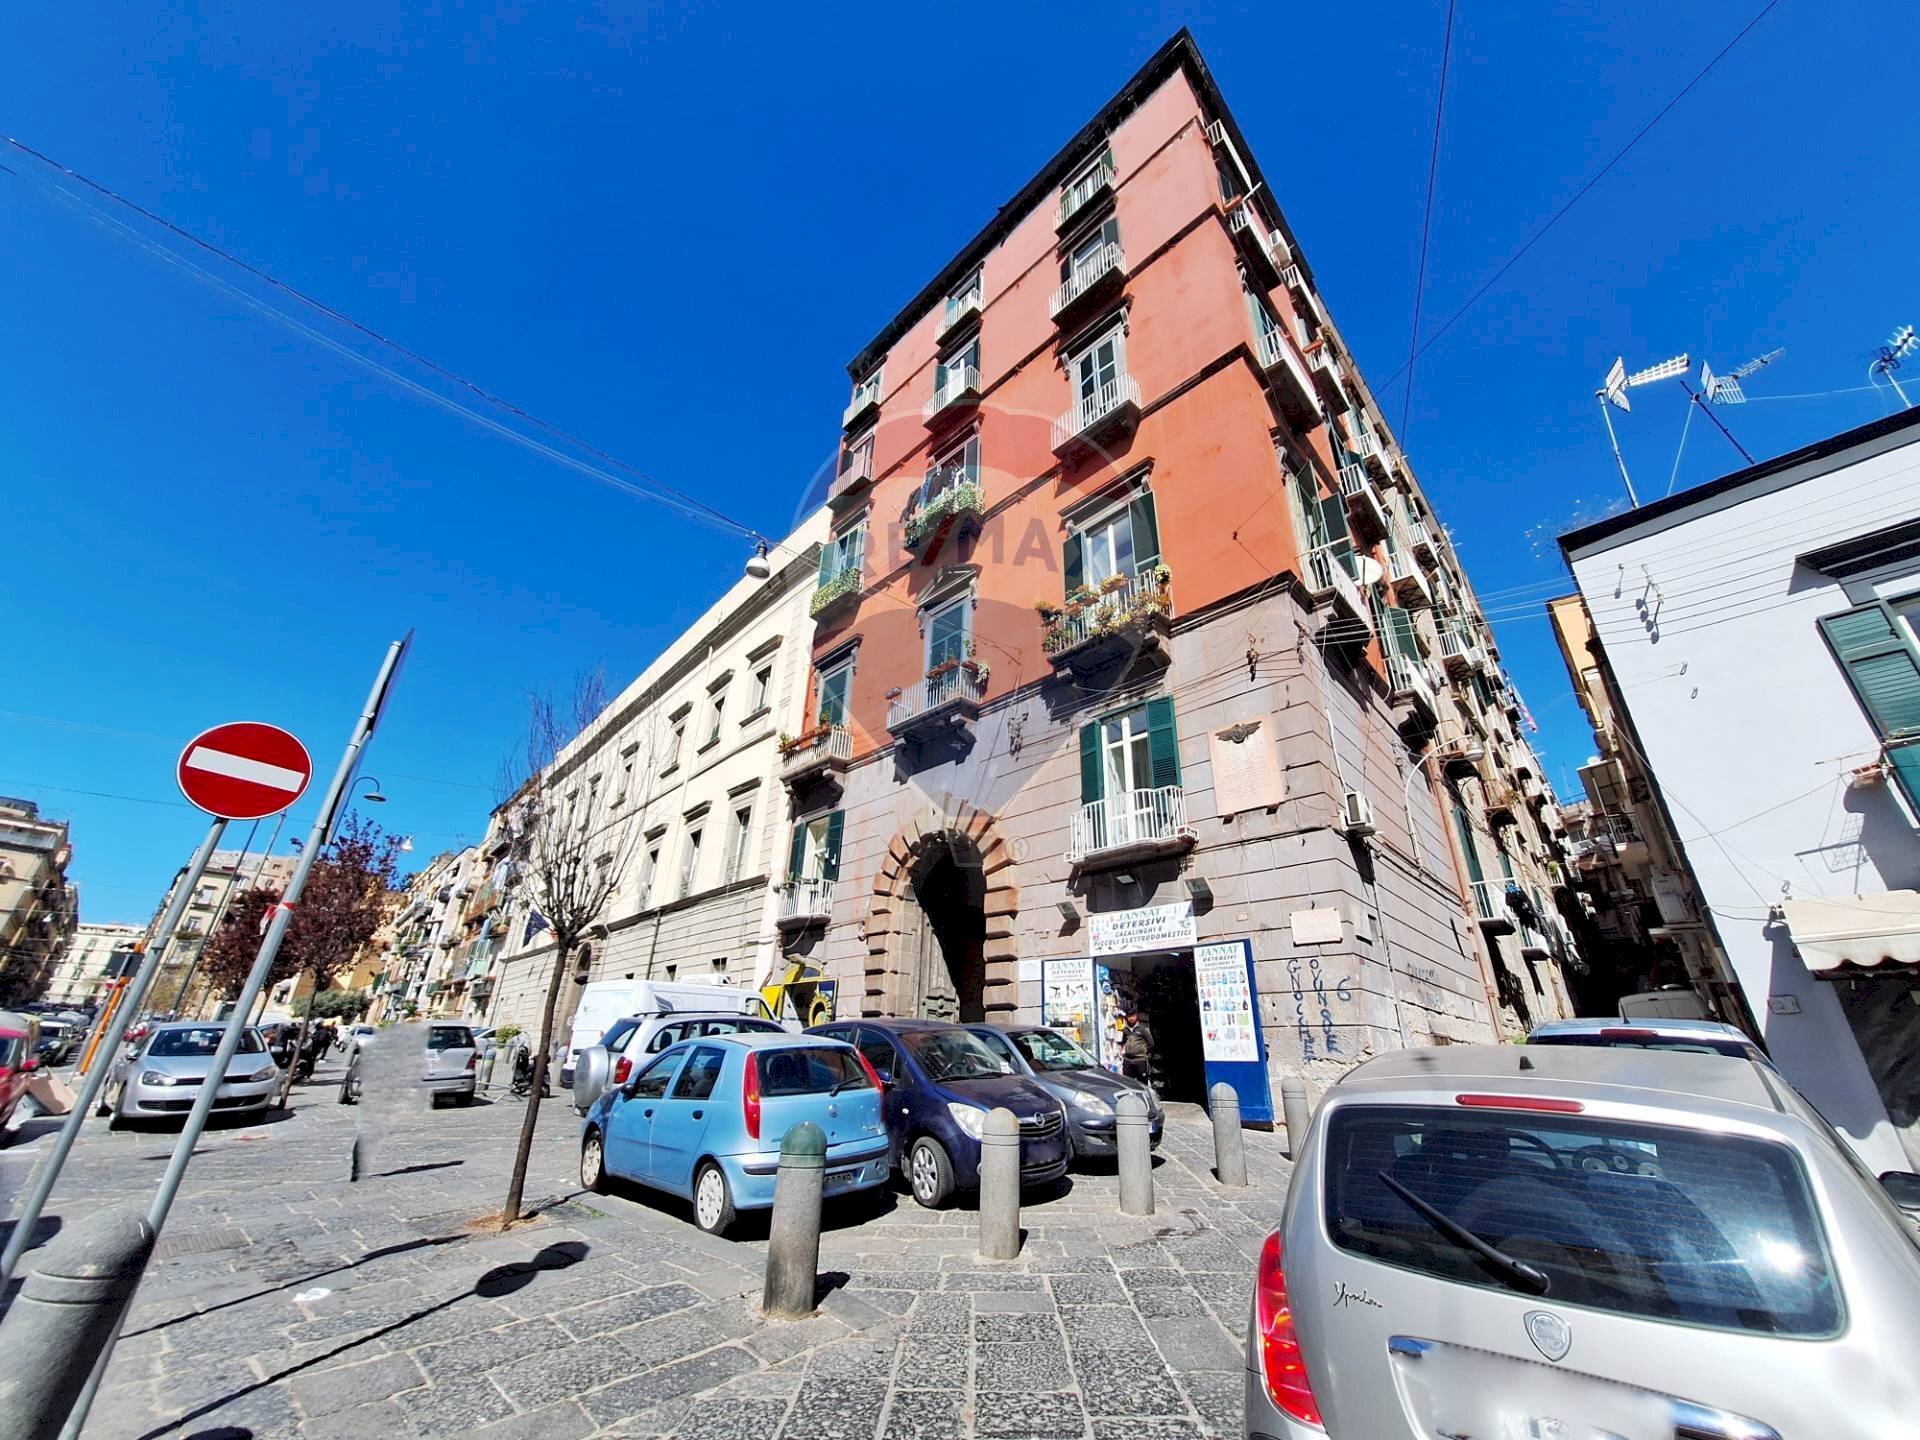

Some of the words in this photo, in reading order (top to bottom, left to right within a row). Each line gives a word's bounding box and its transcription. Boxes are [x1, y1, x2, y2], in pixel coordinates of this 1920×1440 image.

[1119, 907, 1161, 921] JANNAT
[1112, 916, 1167, 930] DETERSIVI
[1094, 937, 1120, 947] PICCOLI
[1121, 929, 1192, 945] ELETTRODOMESTICI
[1115, 927, 1156, 938] CASALINGHI
[1199, 945, 1239, 957] JANNAT
[1050, 961, 1087, 970] JANNAT
[1333, 1282, 1383, 1308] Ypsilon
